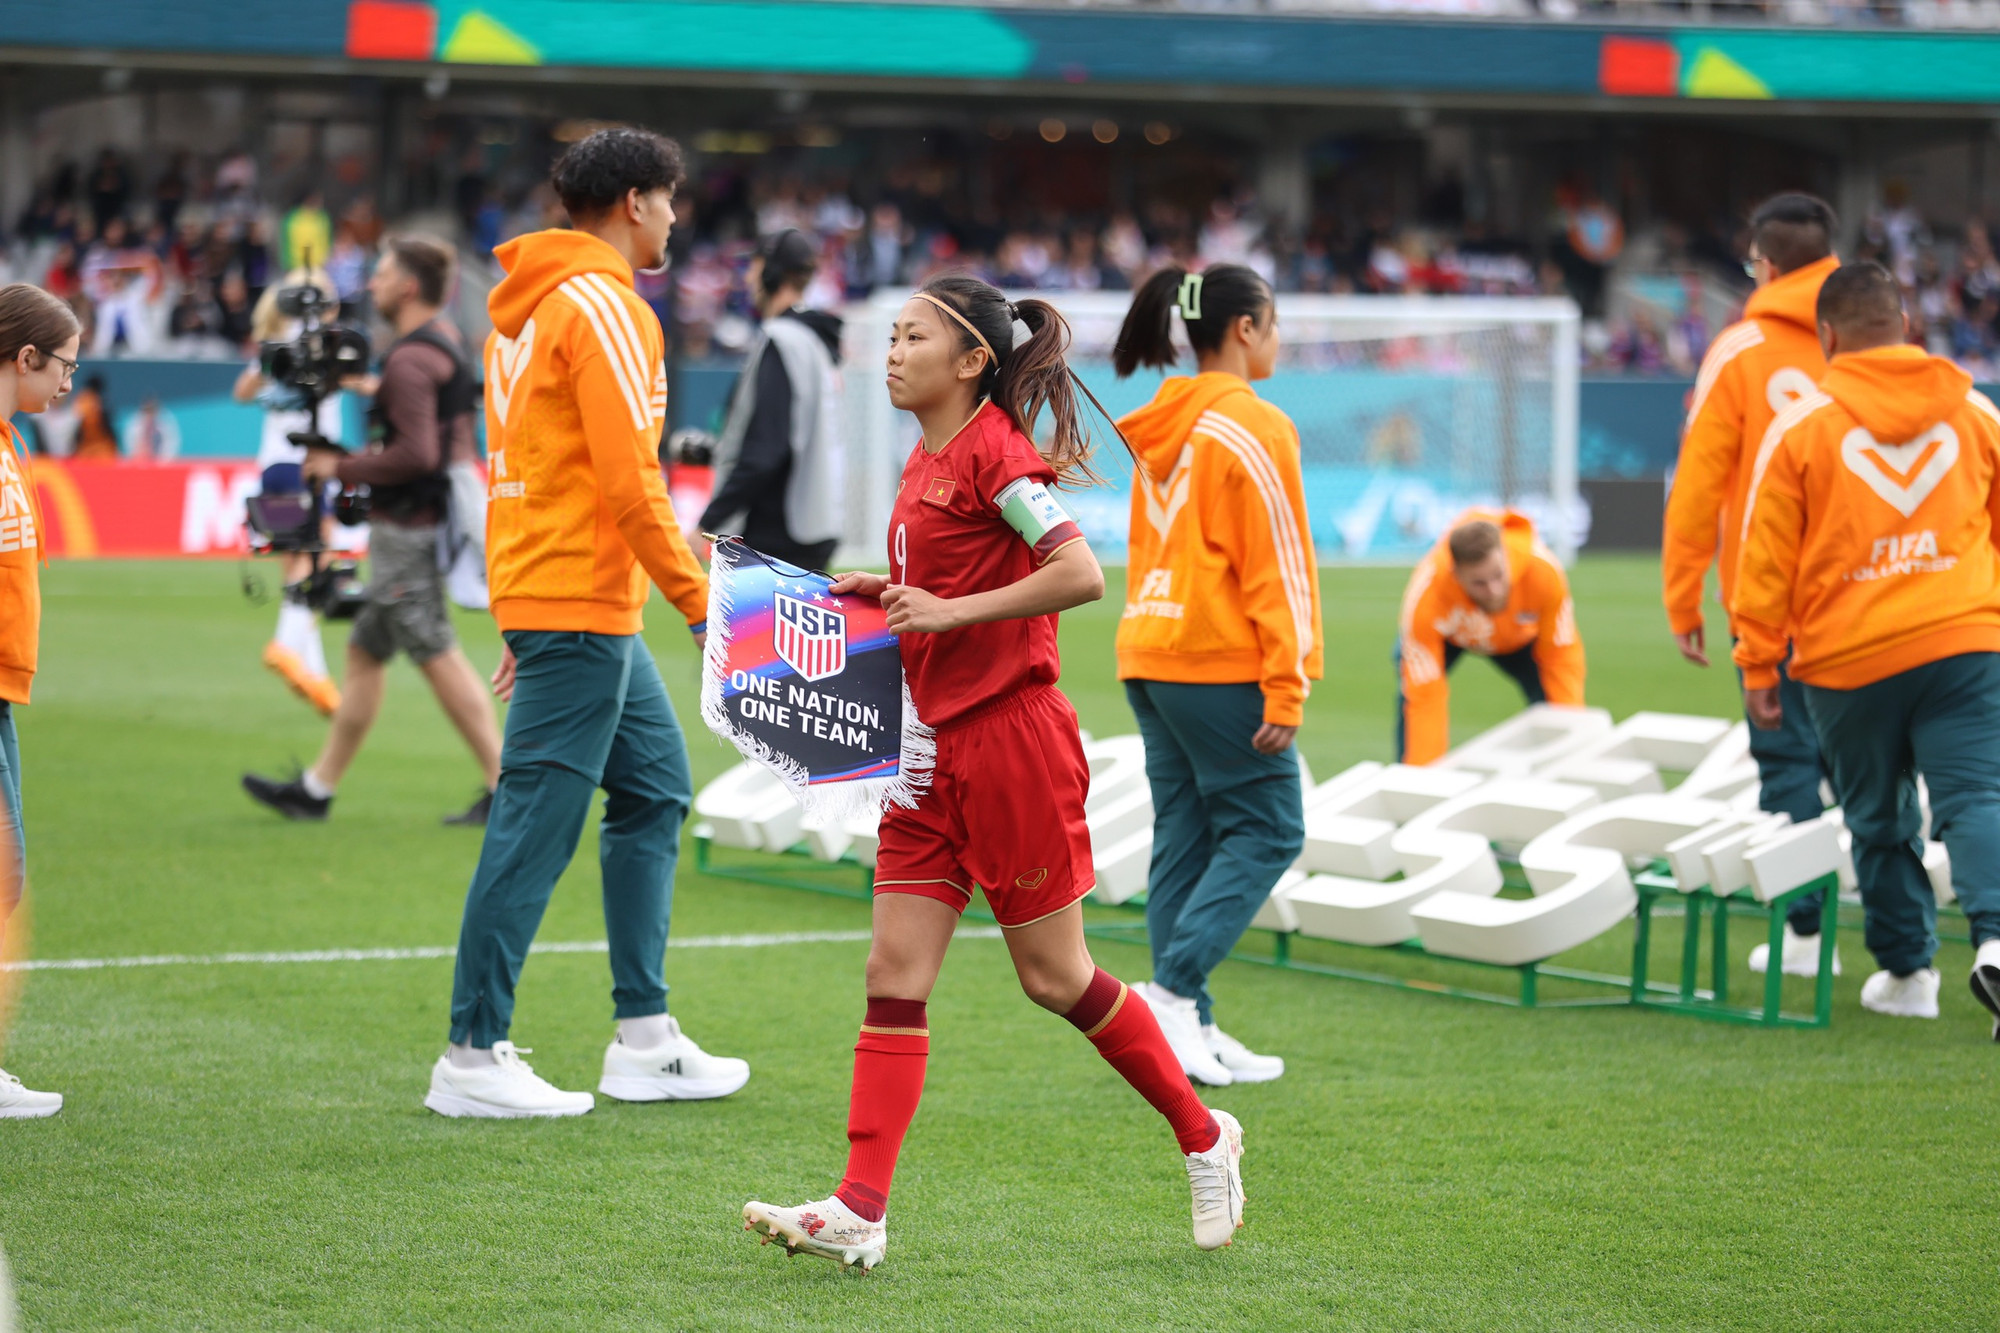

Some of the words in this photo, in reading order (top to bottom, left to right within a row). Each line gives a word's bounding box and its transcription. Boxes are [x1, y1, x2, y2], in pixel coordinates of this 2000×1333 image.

[894, 522, 907, 586] 9
[1870, 529, 1939, 565] FIFA
[779, 597, 841, 635] USA
[731, 669, 782, 701] ONE
[788, 684, 885, 732] NATION.
[740, 697, 791, 729] ONE
[798, 711, 874, 753] TEAM.
